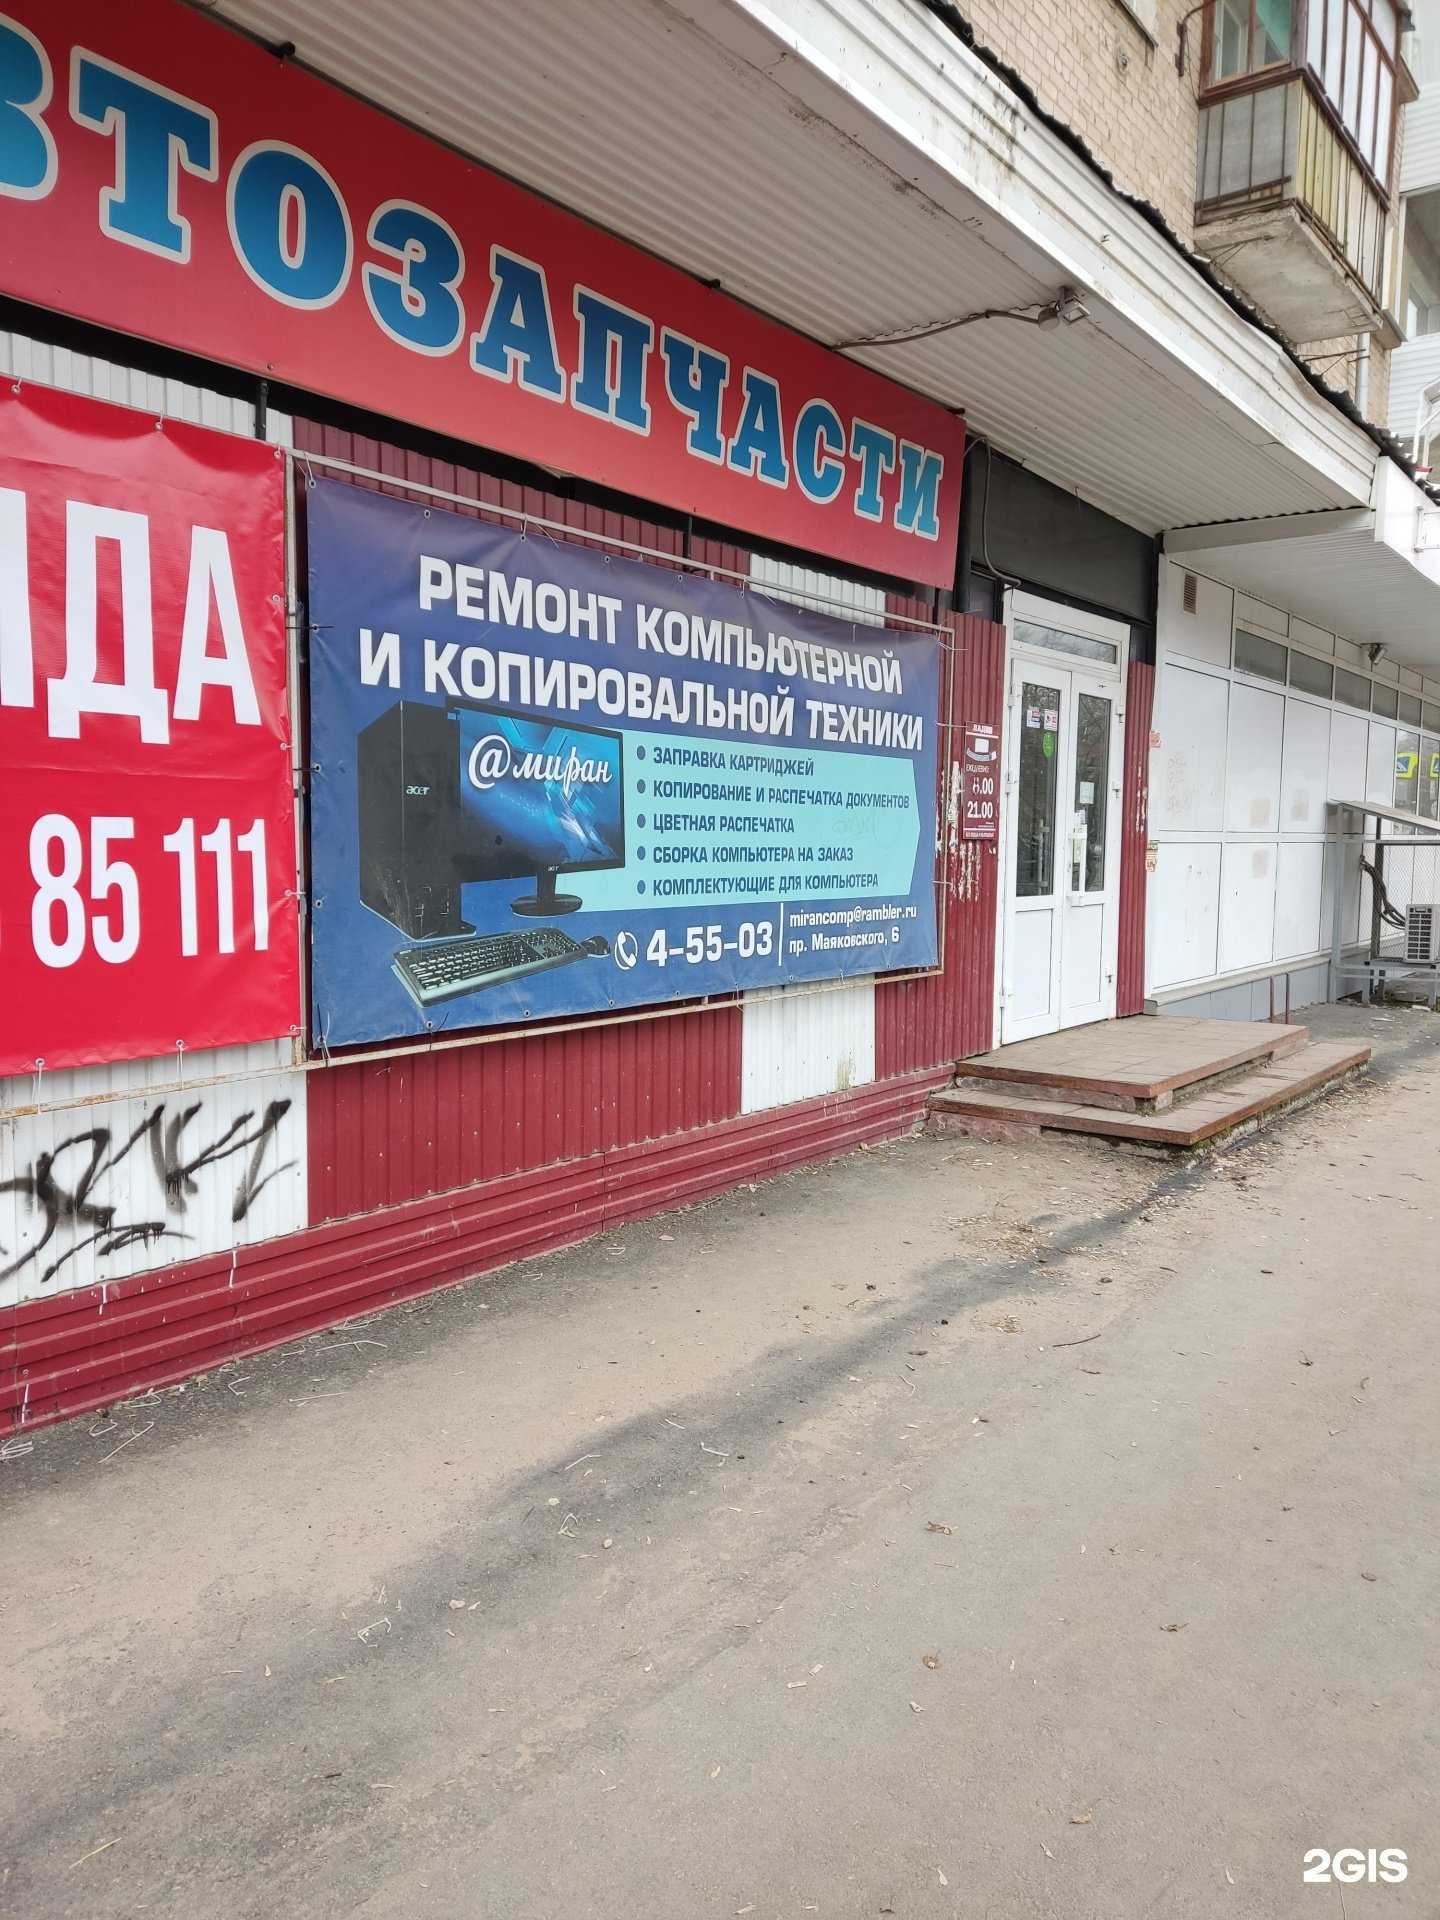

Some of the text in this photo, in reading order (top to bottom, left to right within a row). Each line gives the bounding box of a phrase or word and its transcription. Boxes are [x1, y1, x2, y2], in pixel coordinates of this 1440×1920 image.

[419, 554, 903, 695] РЕМОНТ КОМПЬЮТЕРНОЙ
[359, 628, 923, 750] И КОПИРОВАЛЬНОЙ ТЕХНИКИ
[653, 747, 814, 777] ЗАПРАВКА КАРТРИДЖЕЙ
[653, 780, 910, 809] КОПИРОВАНИЕ И РАСПЕЧАТКА ДОКУМЕНТОВ
[653, 814, 795, 834] ЦВЕТНАЯ РАСПЕЧАТКА
[967, 800, 994, 819] 21.00
[653, 847, 854, 864] СБОРКА КОМПЬЮТЕРА НА ЗАКАЗ
[29, 813, 269, 969] 85 111
[653, 873, 879, 896] КОМПЛЕКТУЮЩИЕ ДЛЯ КОМПЬЮТЕРА
[789, 903, 917, 928] mirancomp@rambler.ru
[646, 921, 773, 967] 4-55-03
[789, 926, 900, 957] пр. Маяковского, 6
